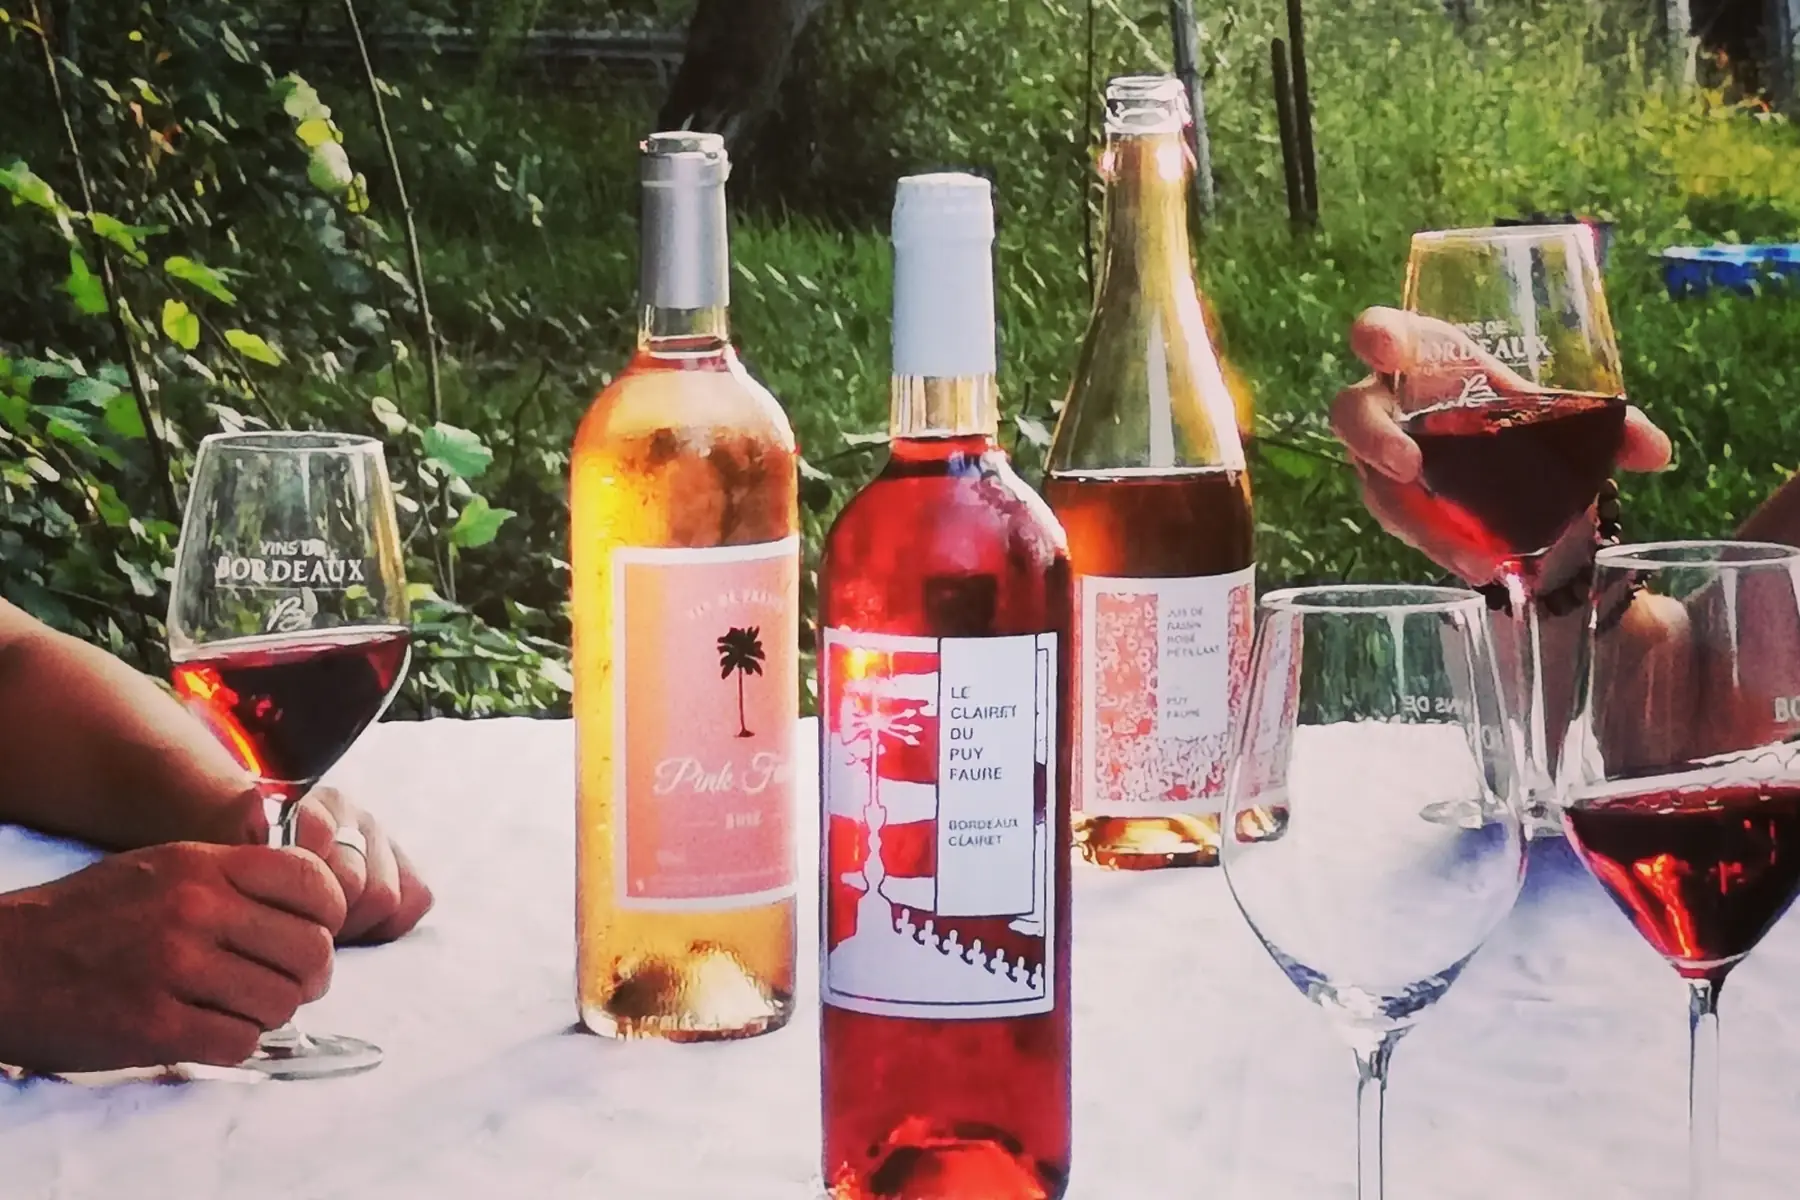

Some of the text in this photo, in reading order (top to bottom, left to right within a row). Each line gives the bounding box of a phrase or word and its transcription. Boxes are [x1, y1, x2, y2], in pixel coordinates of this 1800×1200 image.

[259, 539, 299, 556] VINS
[214, 555, 365, 584] BORDEAUX
[951, 686, 971, 699] LE
[951, 705, 1017, 720] CLAIRET
[951, 727, 974, 740] DU
[950, 747, 984, 761] PUY
[949, 767, 1003, 781] FAURE
